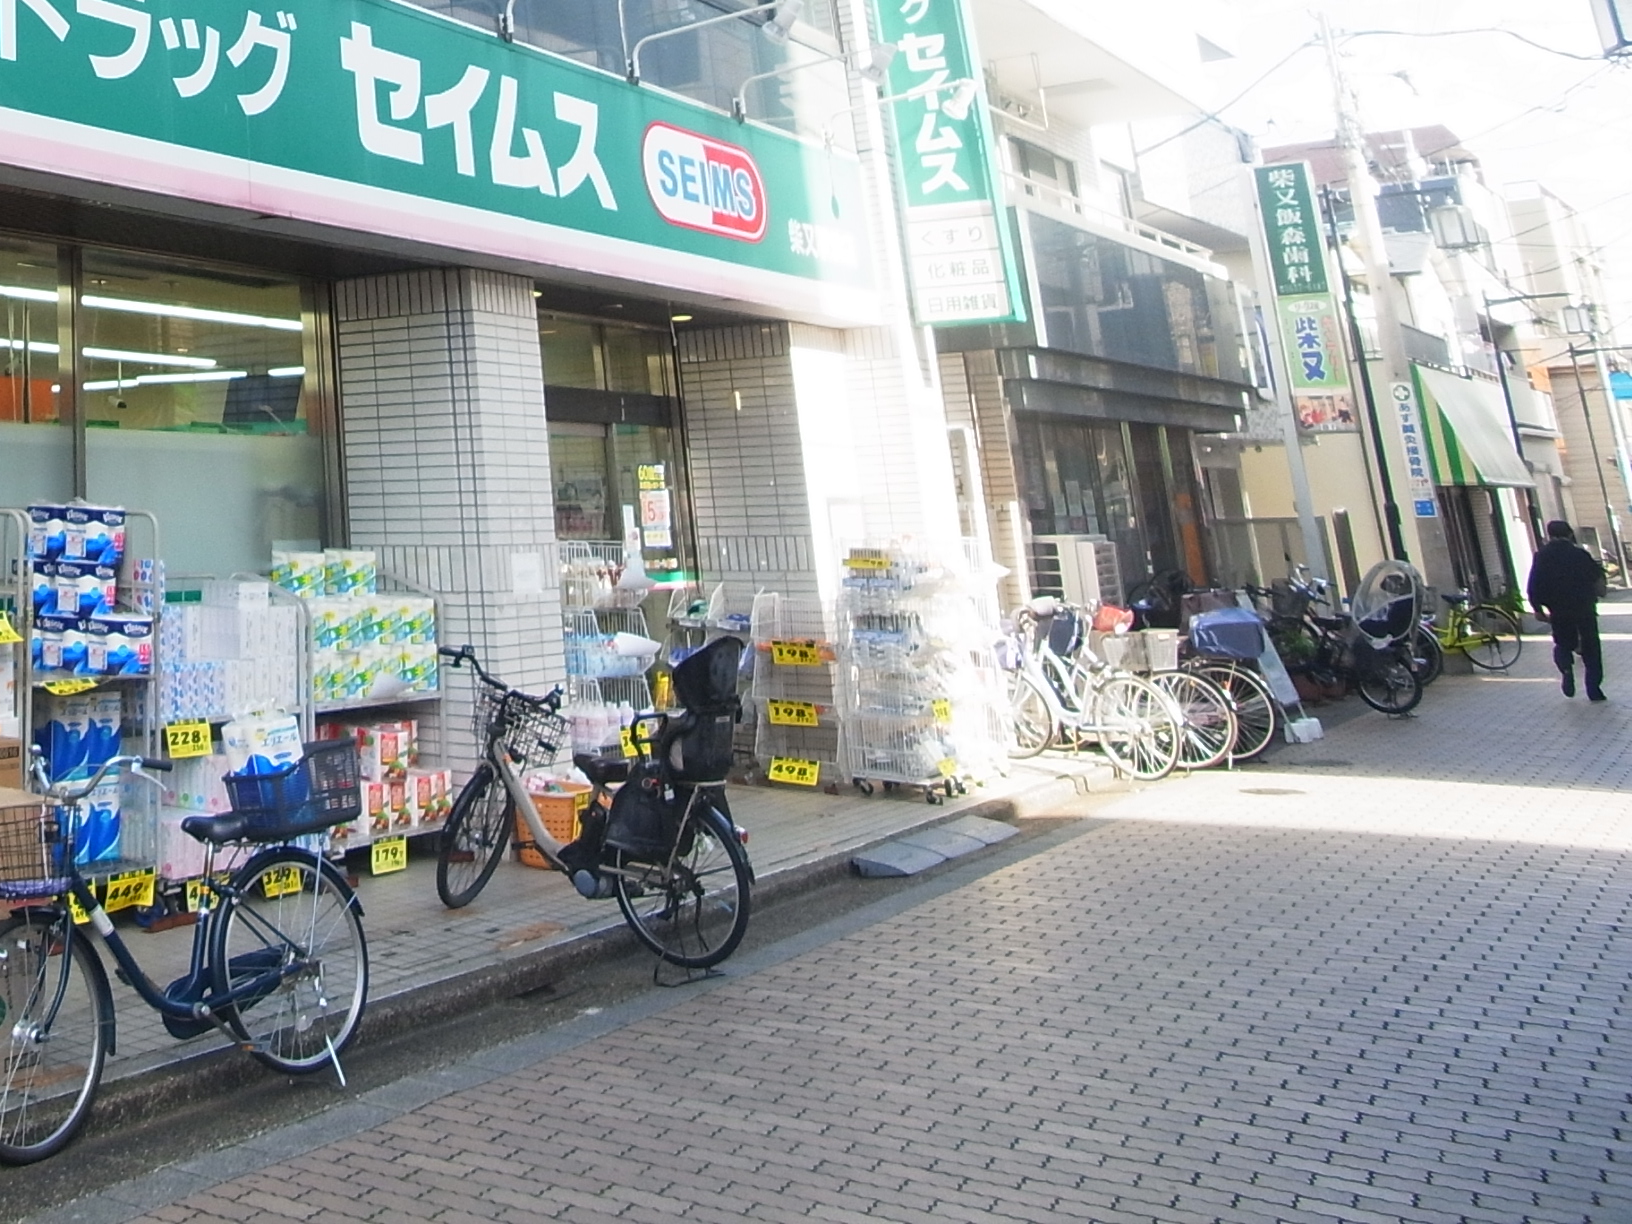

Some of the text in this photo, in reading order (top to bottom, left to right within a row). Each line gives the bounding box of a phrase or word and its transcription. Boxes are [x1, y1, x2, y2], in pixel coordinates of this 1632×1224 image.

[339, 21, 618, 210] セイムス
[896, 31, 970, 197] セイムス
[655, 146, 758, 221] SEIMS
[920, 226, 983, 246] くすり
[927, 259, 990, 279] 化粧品
[928, 292, 999, 313] 日用雑貨
[1294, 316, 1326, 381] 柴又
[776, 648, 809, 659] 198
[773, 707, 807, 718] 198
[169, 730, 202, 746] 228
[261, 735, 298, 748] エリエール
[773, 764, 808, 777] 498
[374, 846, 399, 863] 179
[108, 882, 144, 900] 449
